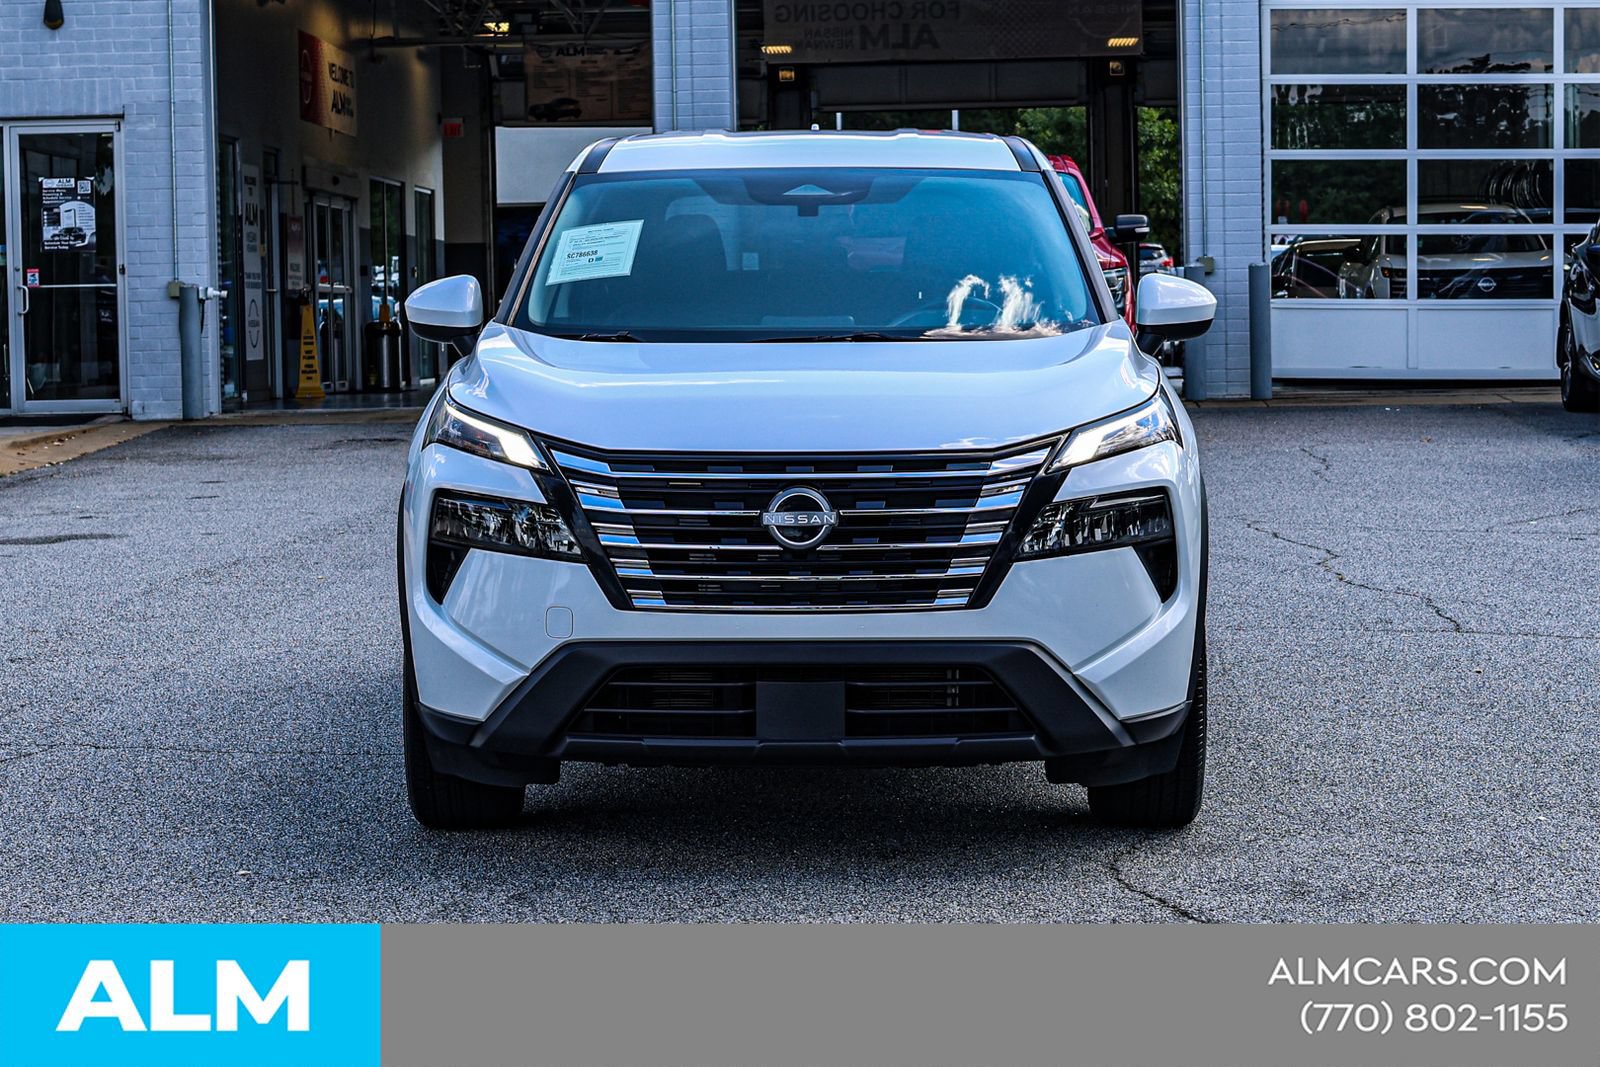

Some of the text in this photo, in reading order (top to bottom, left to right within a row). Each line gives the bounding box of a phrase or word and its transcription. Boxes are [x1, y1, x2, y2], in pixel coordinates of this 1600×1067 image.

[556, 46, 585, 57] ALM
[244, 203, 259, 227] ALM
[764, 514, 836, 524] NISSAN
